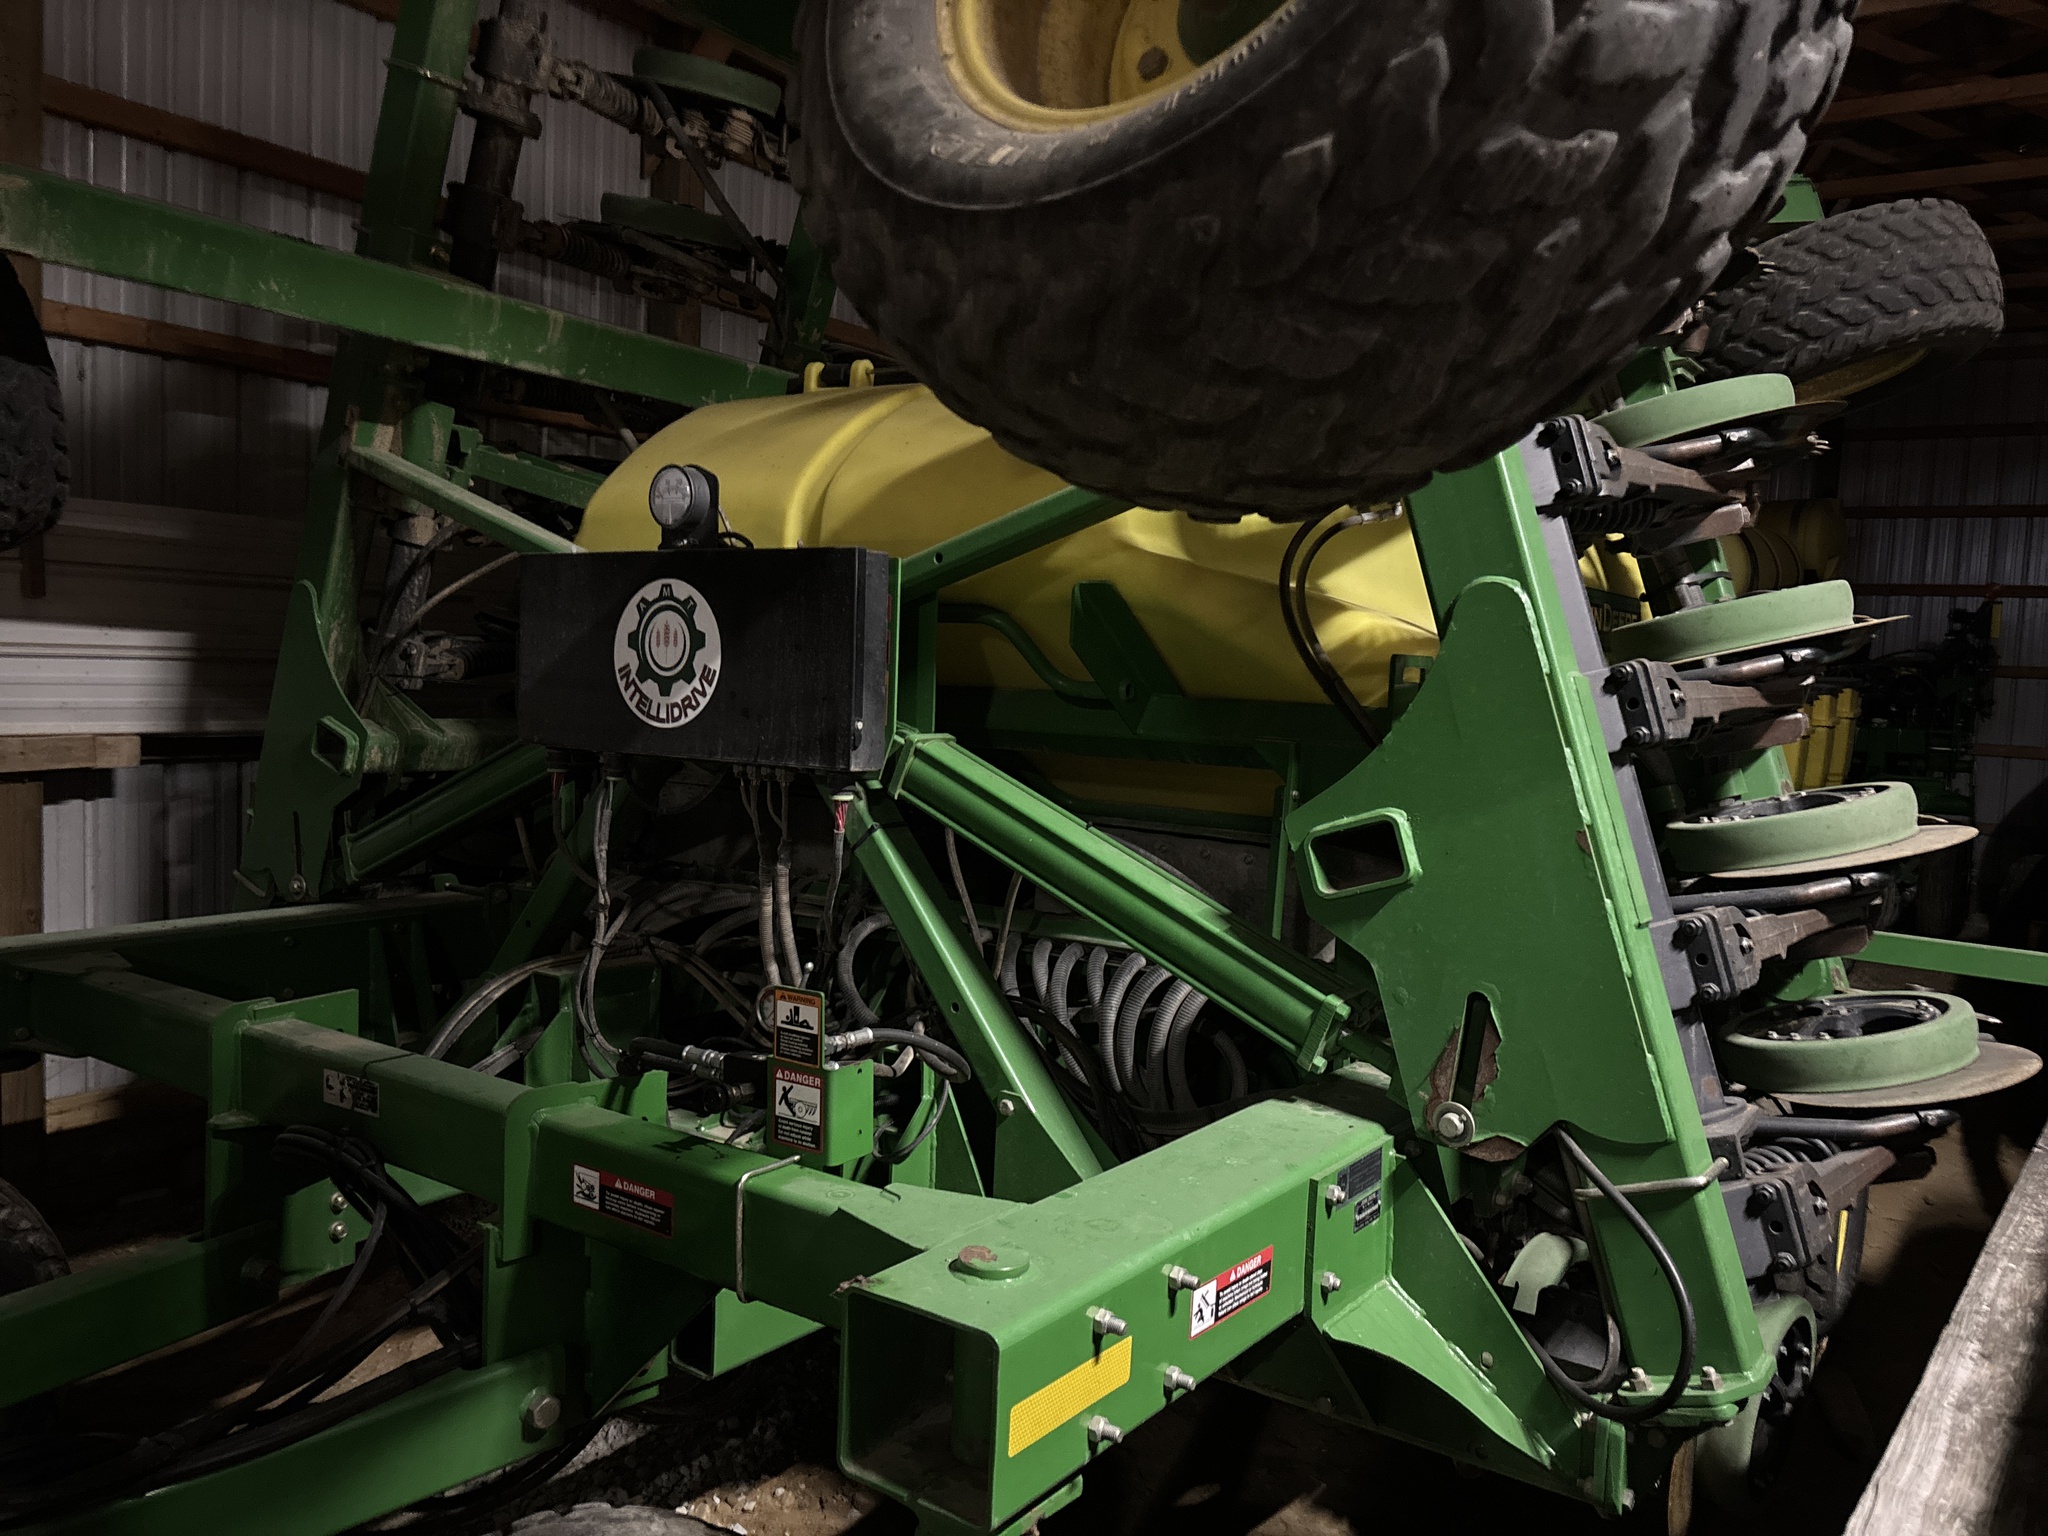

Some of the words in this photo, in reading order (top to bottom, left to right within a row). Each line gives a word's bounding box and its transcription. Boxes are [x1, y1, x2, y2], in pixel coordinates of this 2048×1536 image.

[618, 663, 717, 724] INTELLIDRIVE
[787, 993, 816, 1005] WARNING
[784, 1070, 821, 1087] DANGER
[623, 1181, 656, 1200] DANGER
[1236, 1254, 1262, 1279] DANGER
